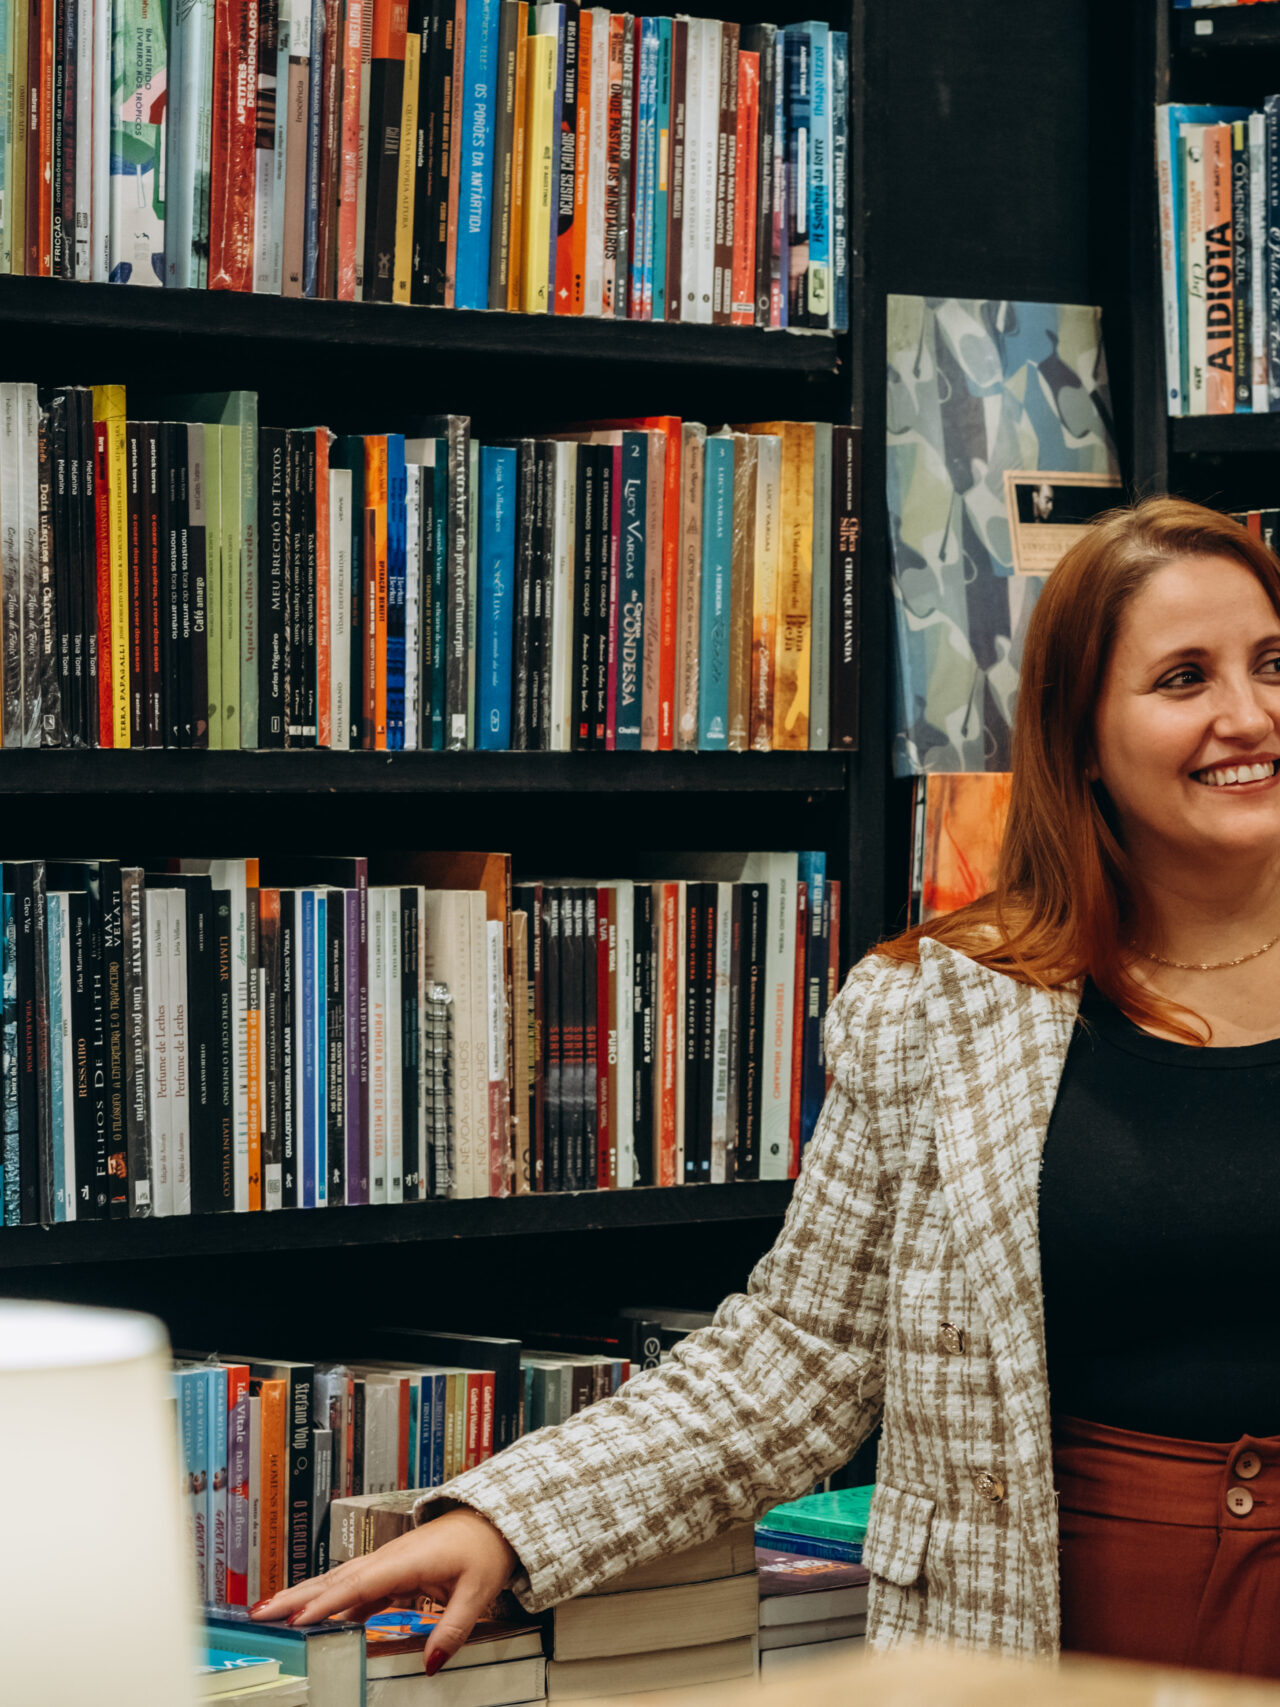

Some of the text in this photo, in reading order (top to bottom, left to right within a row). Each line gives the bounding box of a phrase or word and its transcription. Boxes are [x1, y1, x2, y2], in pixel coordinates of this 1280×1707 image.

[135, 27, 143, 67] LIVREIRO
[144, 28, 154, 90] UM INTRÉPIDO
[135, 93, 144, 136] TRÓPICOS
[468, 83, 489, 233] OS PORÕES DA ANTÁRTIDA
[605, 83, 622, 260] ONDE PASTAM OS MINOTAUROS
[1235, 163, 1246, 285] O MENINO AZUL
[1205, 221, 1231, 373] A IDIOTA
[271, 447, 283, 610] MEU BRECHÓ DE TEXTOS
[625, 478, 643, 580] LUCY VARGAS
[182, 590, 190, 601] do
[182, 603, 190, 638] armário
[843, 557, 853, 663] CHICA QUE MANDA
[621, 604, 637, 706] CONDESSA
[219, 936, 229, 982] LIMIAR
[608, 1030, 617, 1064] PURO
[236, 1382, 246, 1443] Ida Vitale
[294, 1383, 310, 1449] Stefano Volp
[483, 1386, 492, 1447] Gabriel Waldman
